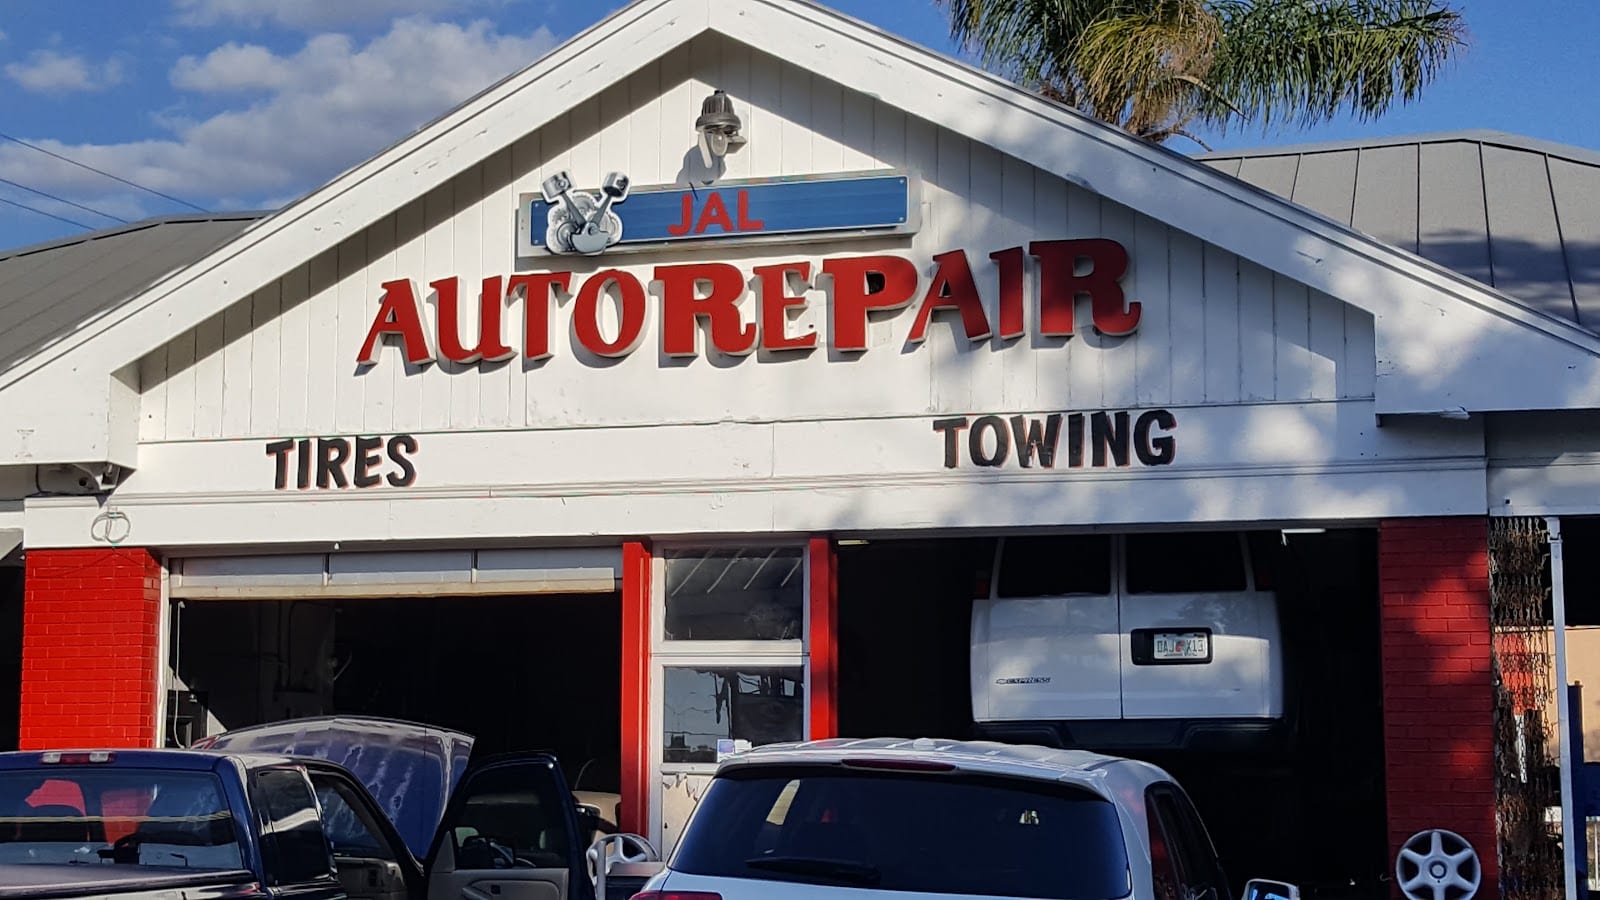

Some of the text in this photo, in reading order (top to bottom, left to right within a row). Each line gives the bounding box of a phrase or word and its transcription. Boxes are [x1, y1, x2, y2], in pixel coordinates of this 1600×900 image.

[668, 190, 763, 236] JAL
[266, 434, 419, 490] TIRES
[933, 410, 1177, 469] TOWING
